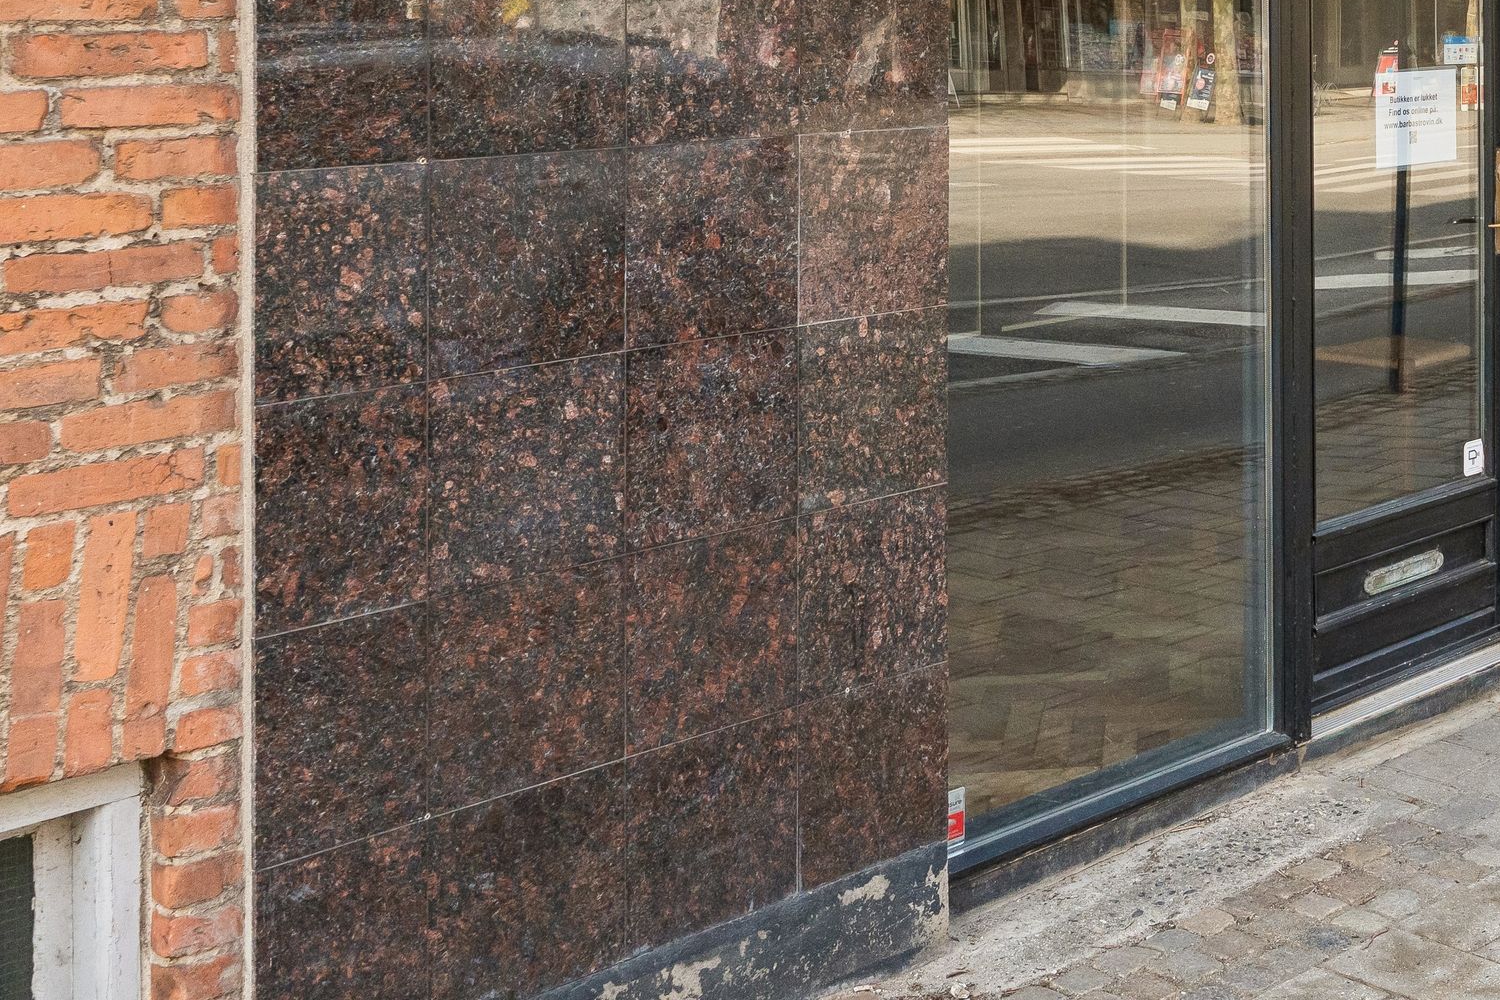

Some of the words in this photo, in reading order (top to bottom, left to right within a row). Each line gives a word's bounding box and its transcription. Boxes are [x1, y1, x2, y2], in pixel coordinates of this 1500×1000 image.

[1390, 96, 1413, 104] Butikken
[1421, 93, 1438, 102] lukket
[1389, 108, 1402, 116] Find
